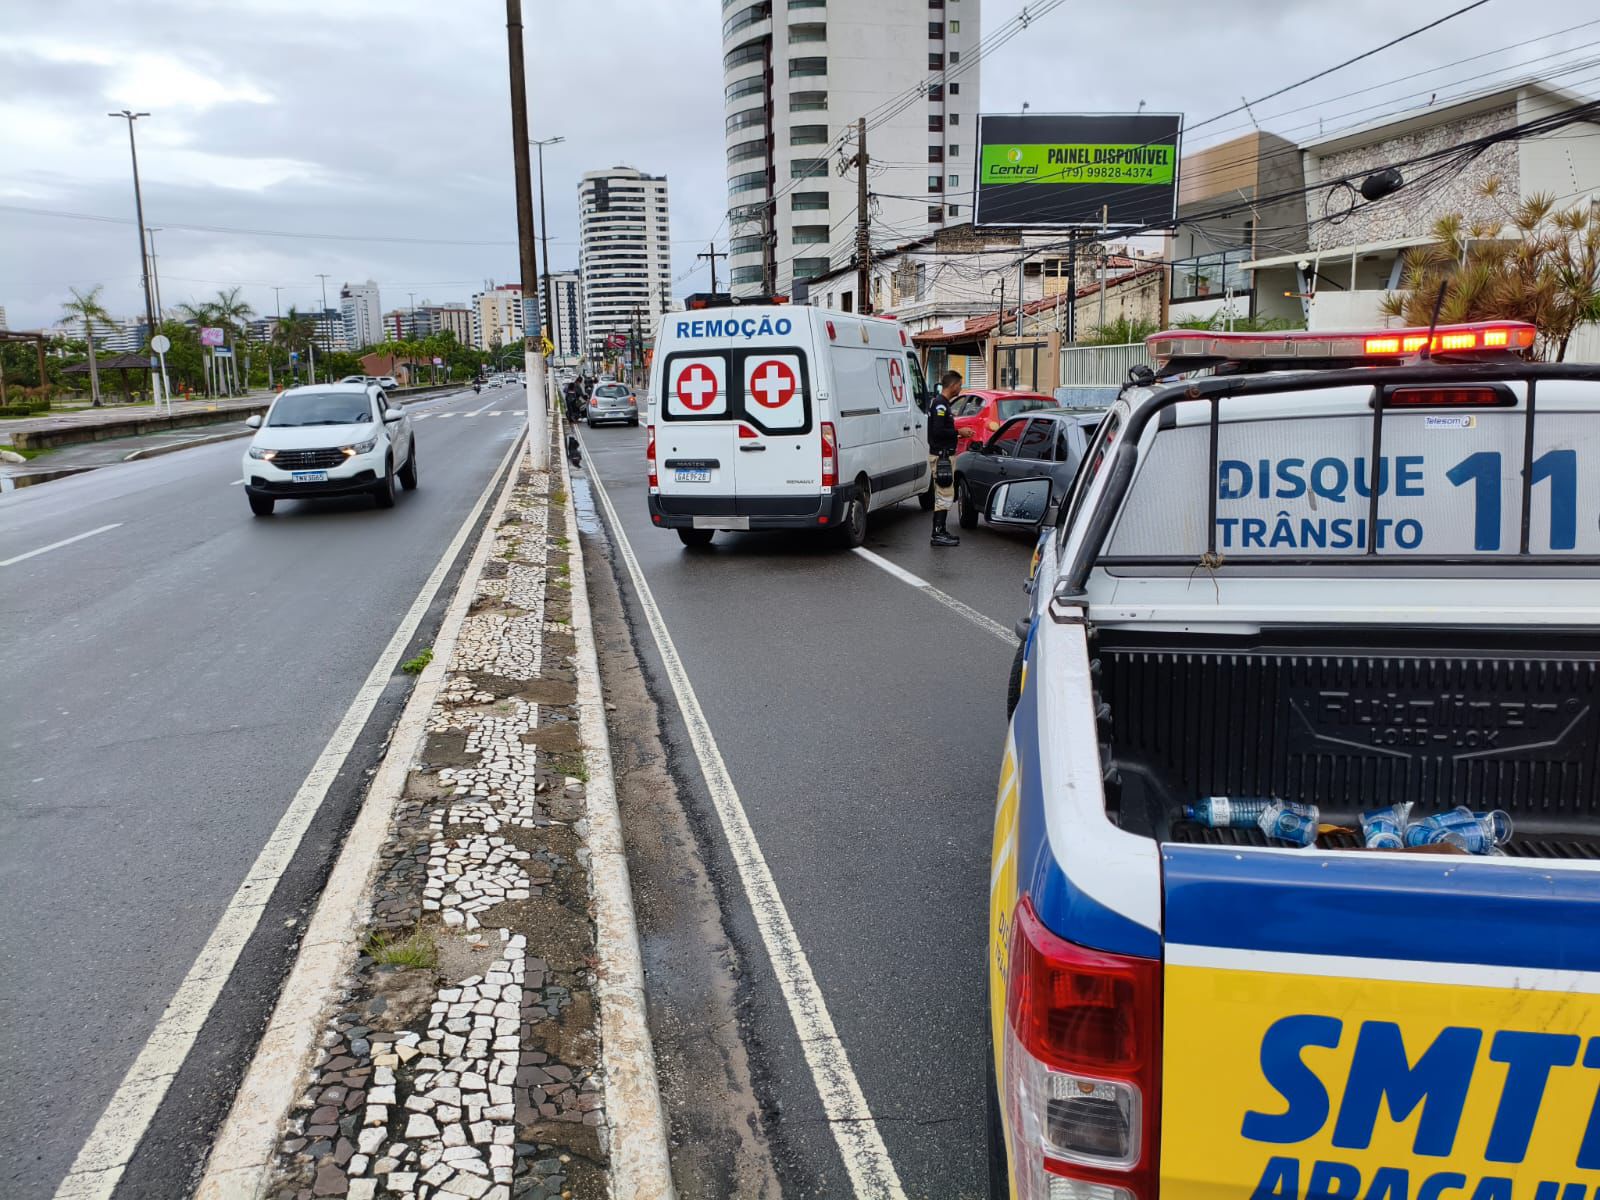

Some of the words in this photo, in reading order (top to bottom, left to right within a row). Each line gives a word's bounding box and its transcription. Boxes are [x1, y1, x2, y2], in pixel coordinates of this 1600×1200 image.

[991, 164, 1039, 175] Central
[1048, 149, 1090, 164] PAINEL
[1061, 167, 1083, 179] (79)
[1087, 168, 1153, 178] 99828-4374
[676, 314, 792, 340] REMOÇÃO
[1218, 456, 1424, 503] DISQUE
[1445, 449, 1600, 551] 11
[1216, 510, 1423, 549] TRÂNSITO
[1241, 1014, 1600, 1170] SMT
